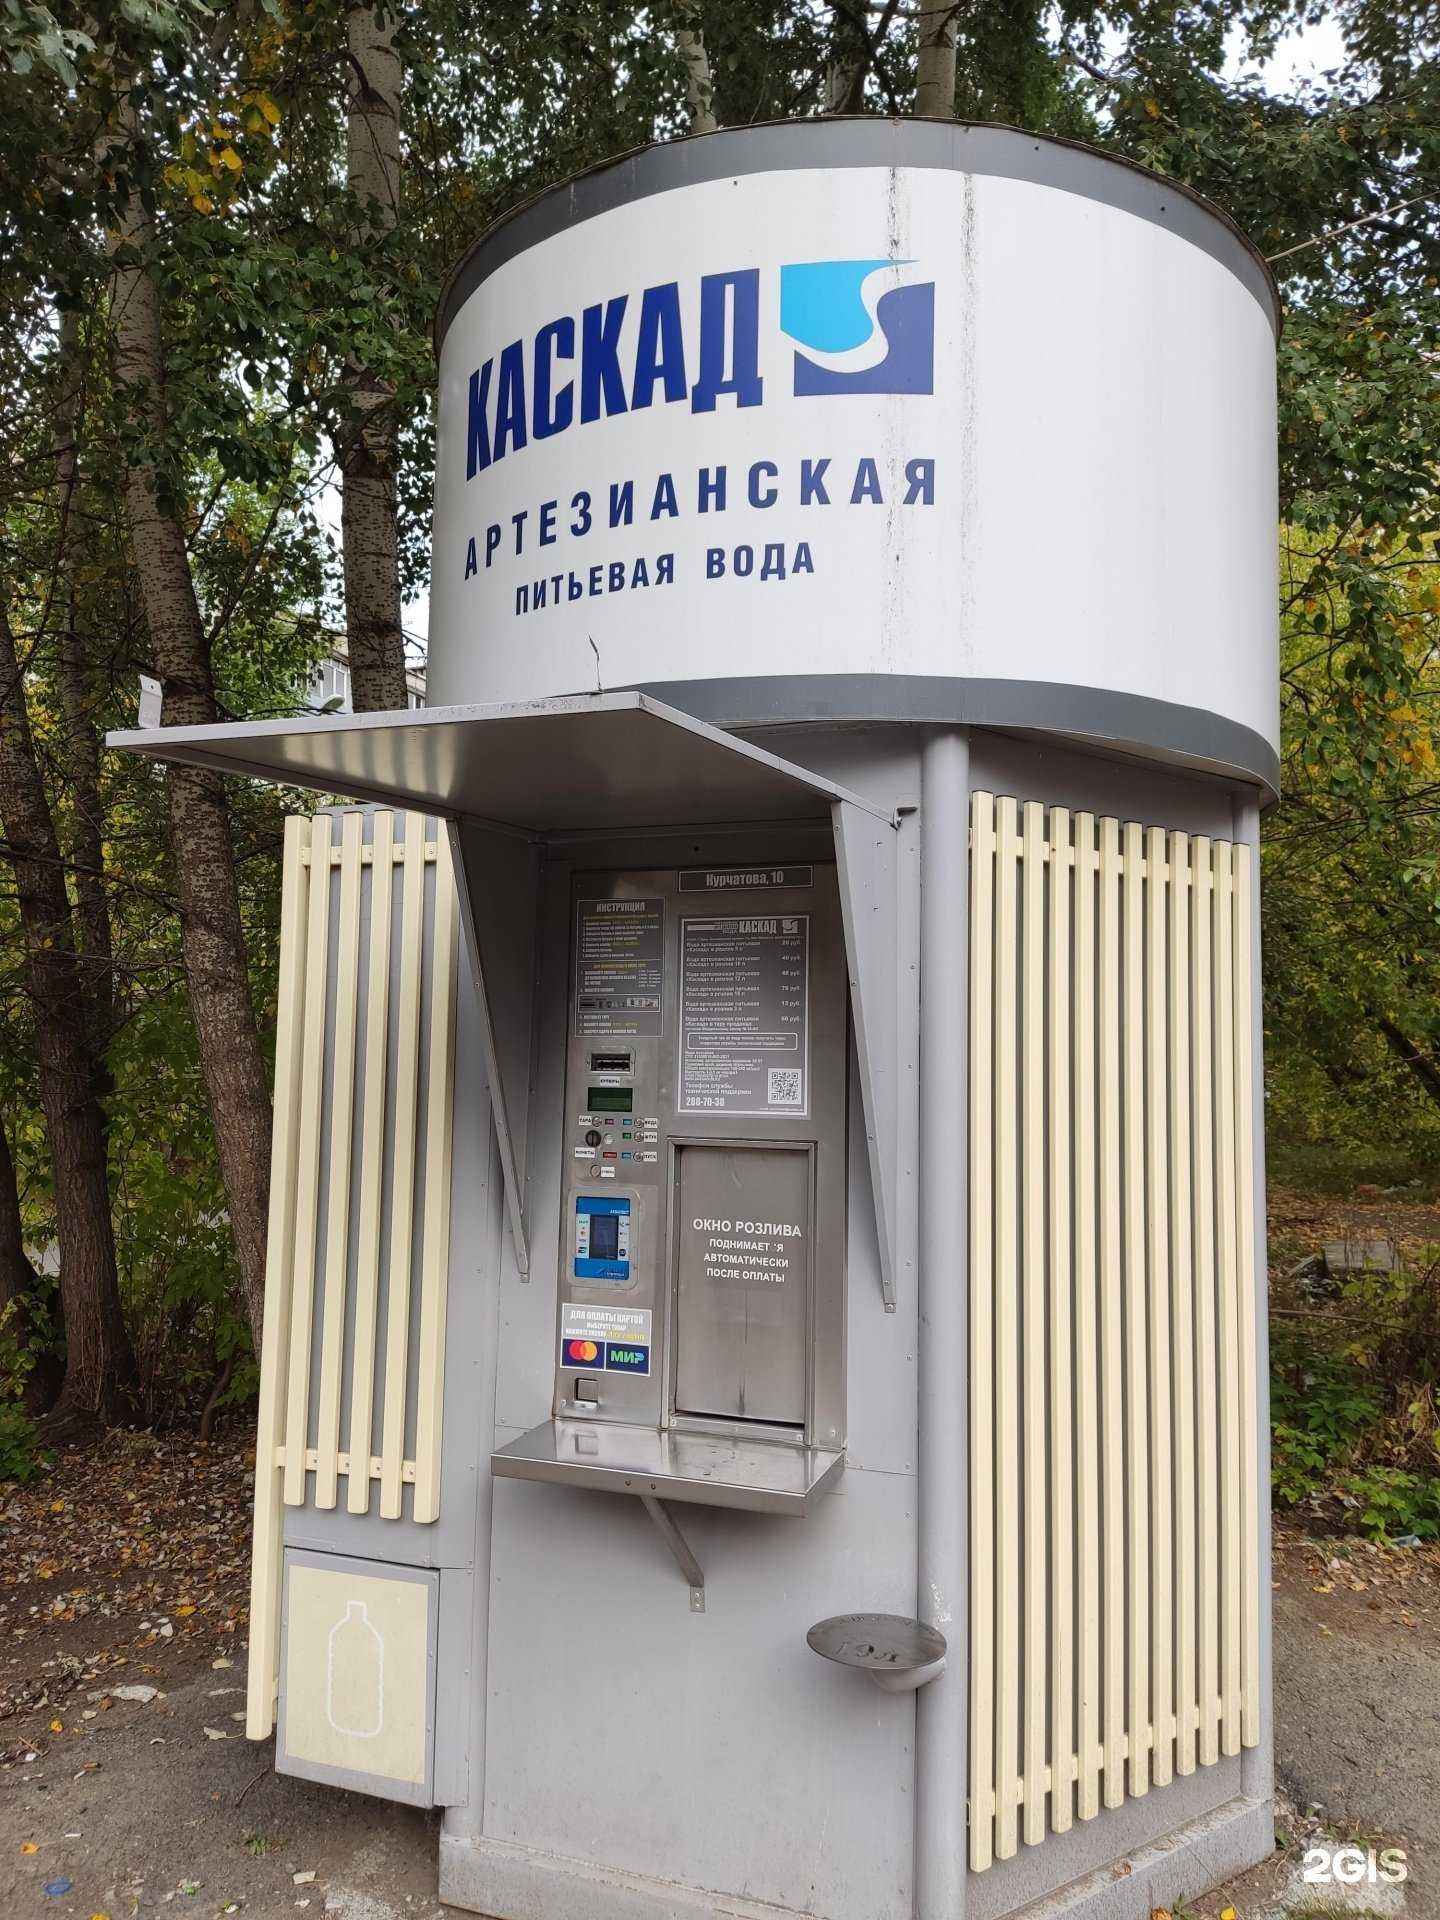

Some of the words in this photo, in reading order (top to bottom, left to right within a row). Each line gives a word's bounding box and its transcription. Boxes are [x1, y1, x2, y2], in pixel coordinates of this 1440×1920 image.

[466, 267, 763, 482] КАСКАД
[464, 458, 935, 580] АРТЕЗИАНСКАЯ
[515, 553, 675, 616] ПИТЬЕВАЯ
[706, 541, 815, 582] ВОДА
[706, 873, 769, 887] Курчатова,
[771, 870, 784, 884] 10
[739, 919, 777, 934] КАСКАД
[693, 1218, 731, 1232] ОКНО
[735, 1221, 802, 1237] РОЗЛИВА
[703, 1253, 789, 1268] АВТОМАТИЧЕСКИ
[706, 1267, 740, 1279] ПОСЛЕ
[742, 1271, 785, 1283] ОПЛАТЫ
[610, 1350, 645, 1364] МИР
